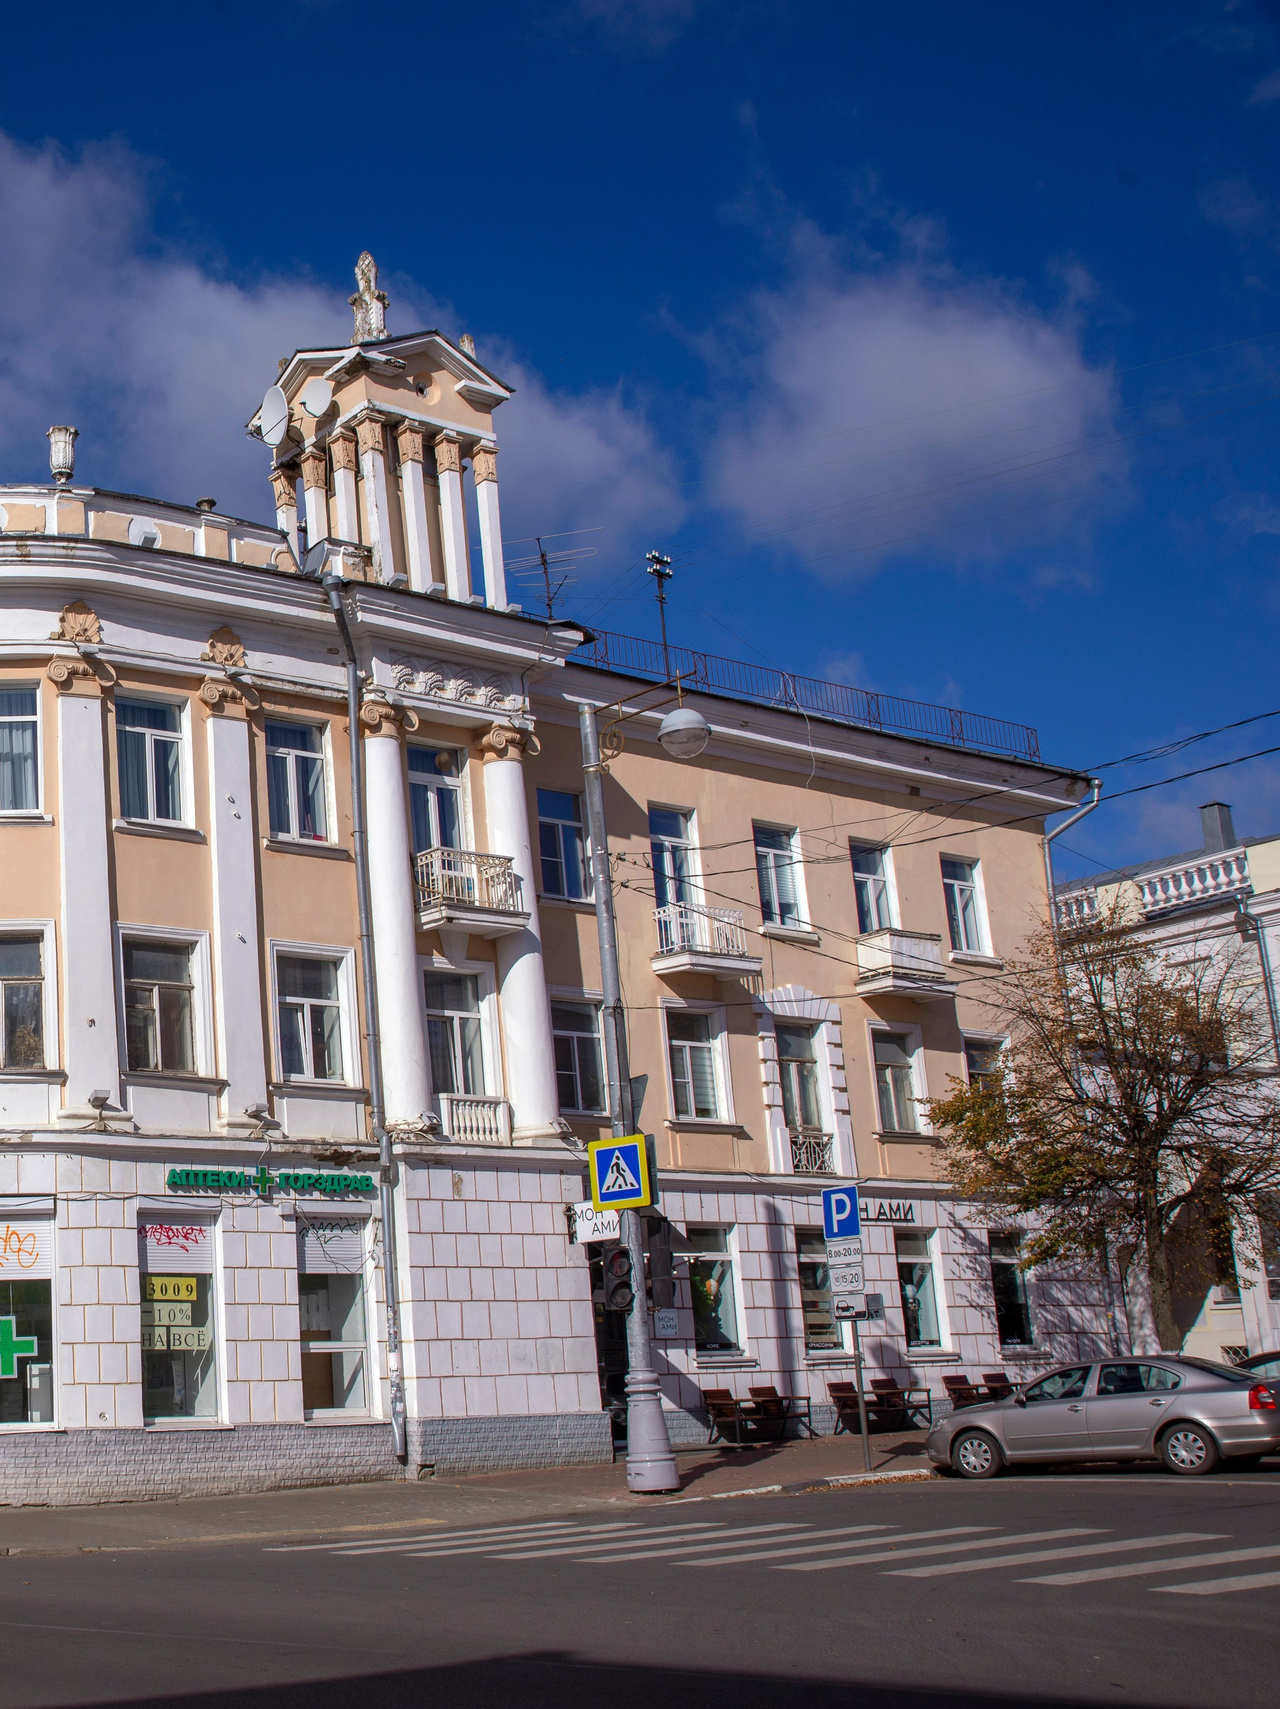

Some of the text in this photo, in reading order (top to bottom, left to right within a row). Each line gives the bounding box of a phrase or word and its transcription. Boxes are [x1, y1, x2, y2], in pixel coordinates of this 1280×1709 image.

[167, 1168, 374, 1193] АПТЕКИ ГОРЗДРАВ
[575, 1207, 604, 1221] МОН
[831, 1193, 851, 1233] P
[876, 1202, 914, 1220] АМИ
[591, 1219, 620, 1235] АМИ
[828, 1247, 861, 1259] 8.00-20.00
[841, 1274, 848, 1284] 15
[849, 1273, 859, 1283] 20
[661, 1322, 677, 1331] АМИ
[142, 1330, 206, 1347] НА ВСЁ
